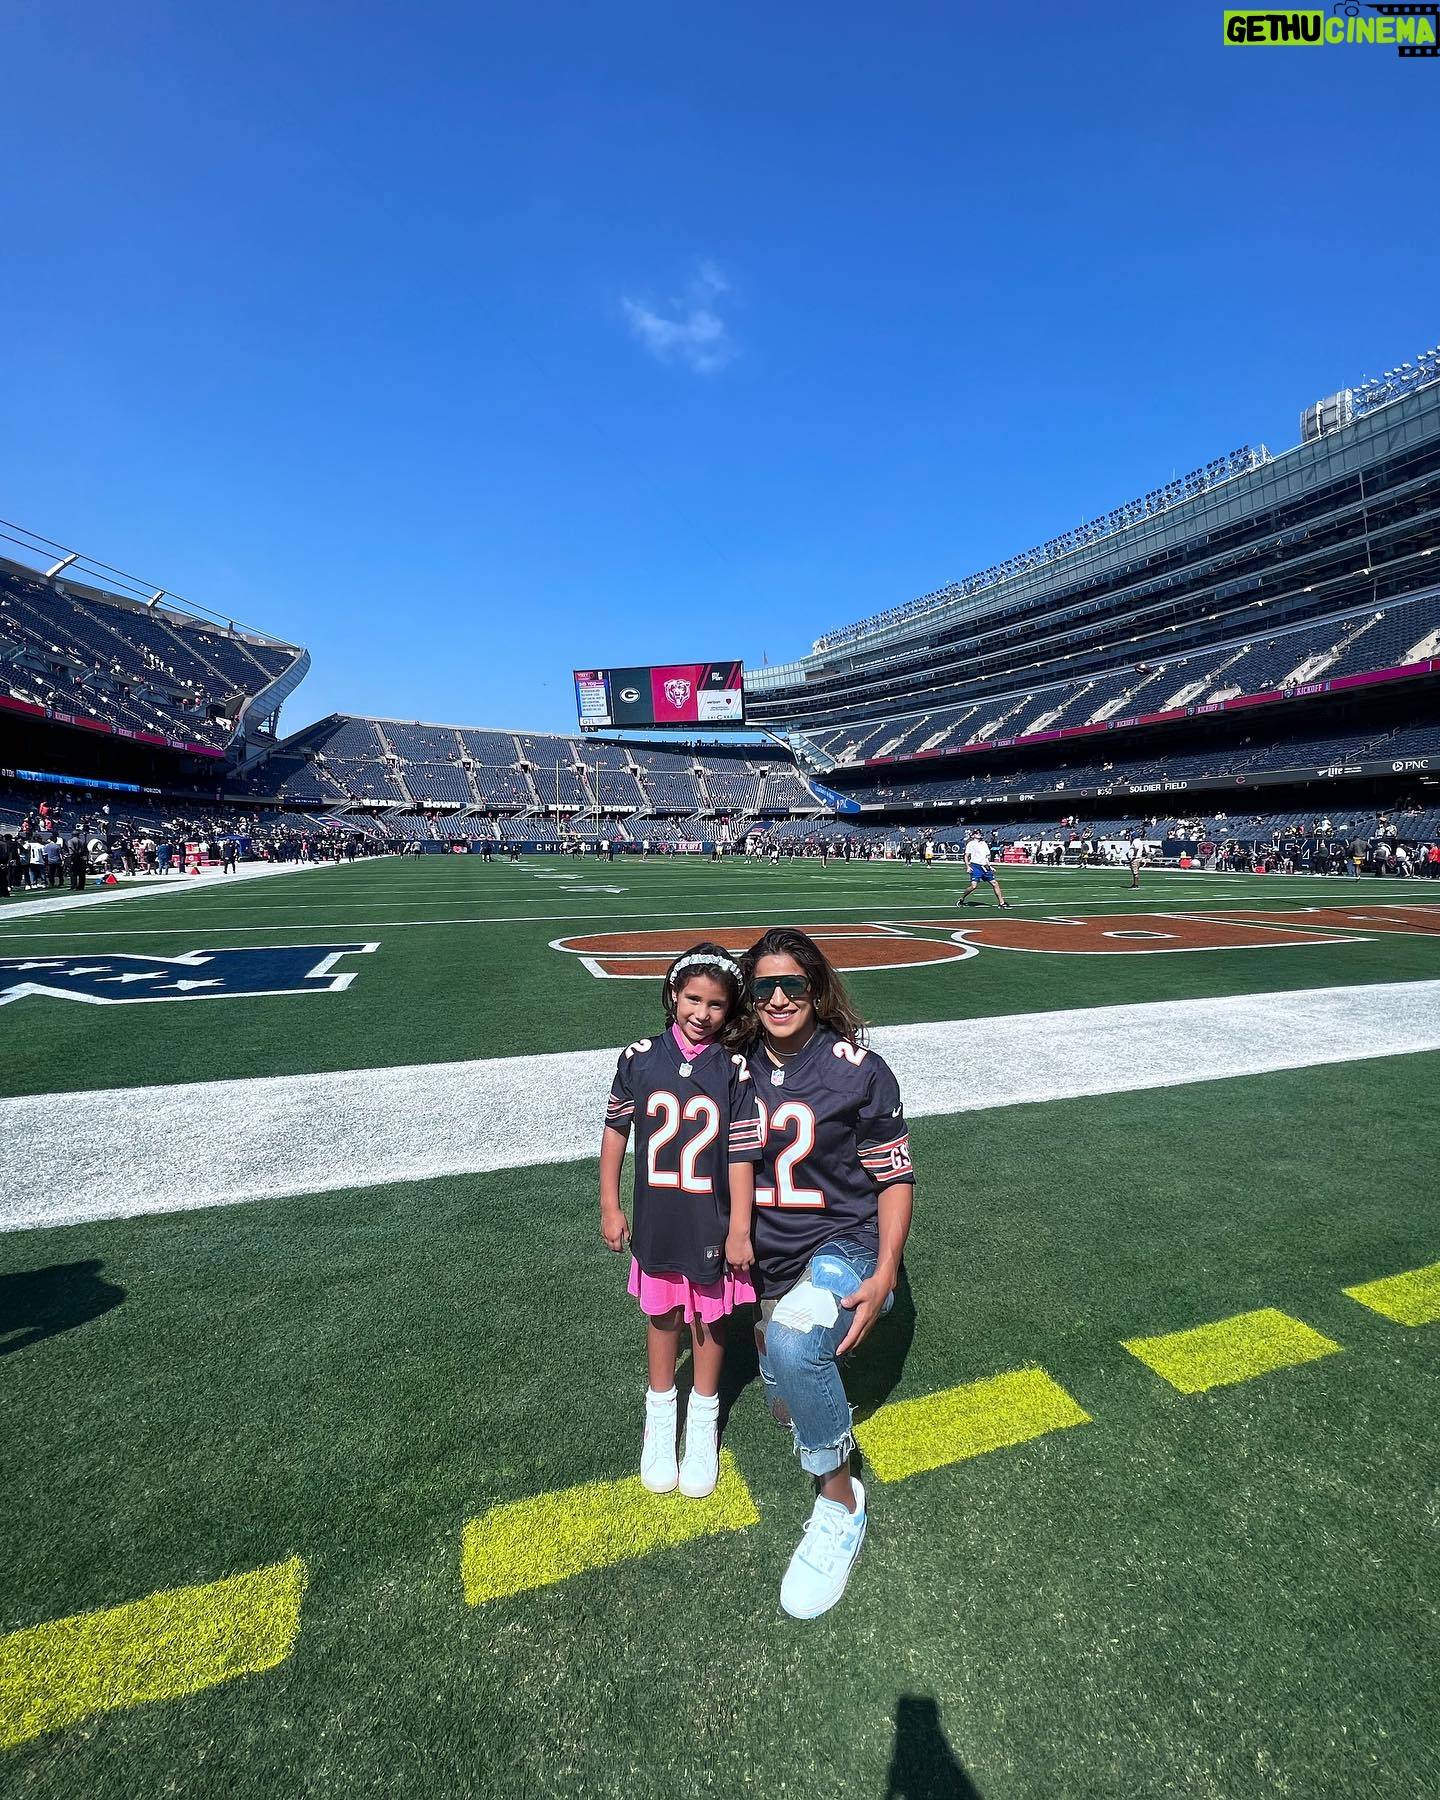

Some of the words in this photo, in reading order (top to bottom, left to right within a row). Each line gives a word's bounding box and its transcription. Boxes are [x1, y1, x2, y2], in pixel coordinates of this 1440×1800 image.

[1297, 684, 1323, 696] KICKOFF
[1197, 704, 1218, 714] KICKOFF
[1116, 719, 1135, 728] KICKOFF
[1405, 760, 1429, 770] PNC
[1327, 767, 1343, 777] Lite
[1129, 784, 1161, 793] SOLDIER
[1164, 782, 1188, 790] FIELD
[423, 801, 461, 809] DOWN
[646, 1090, 720, 1194] 22
